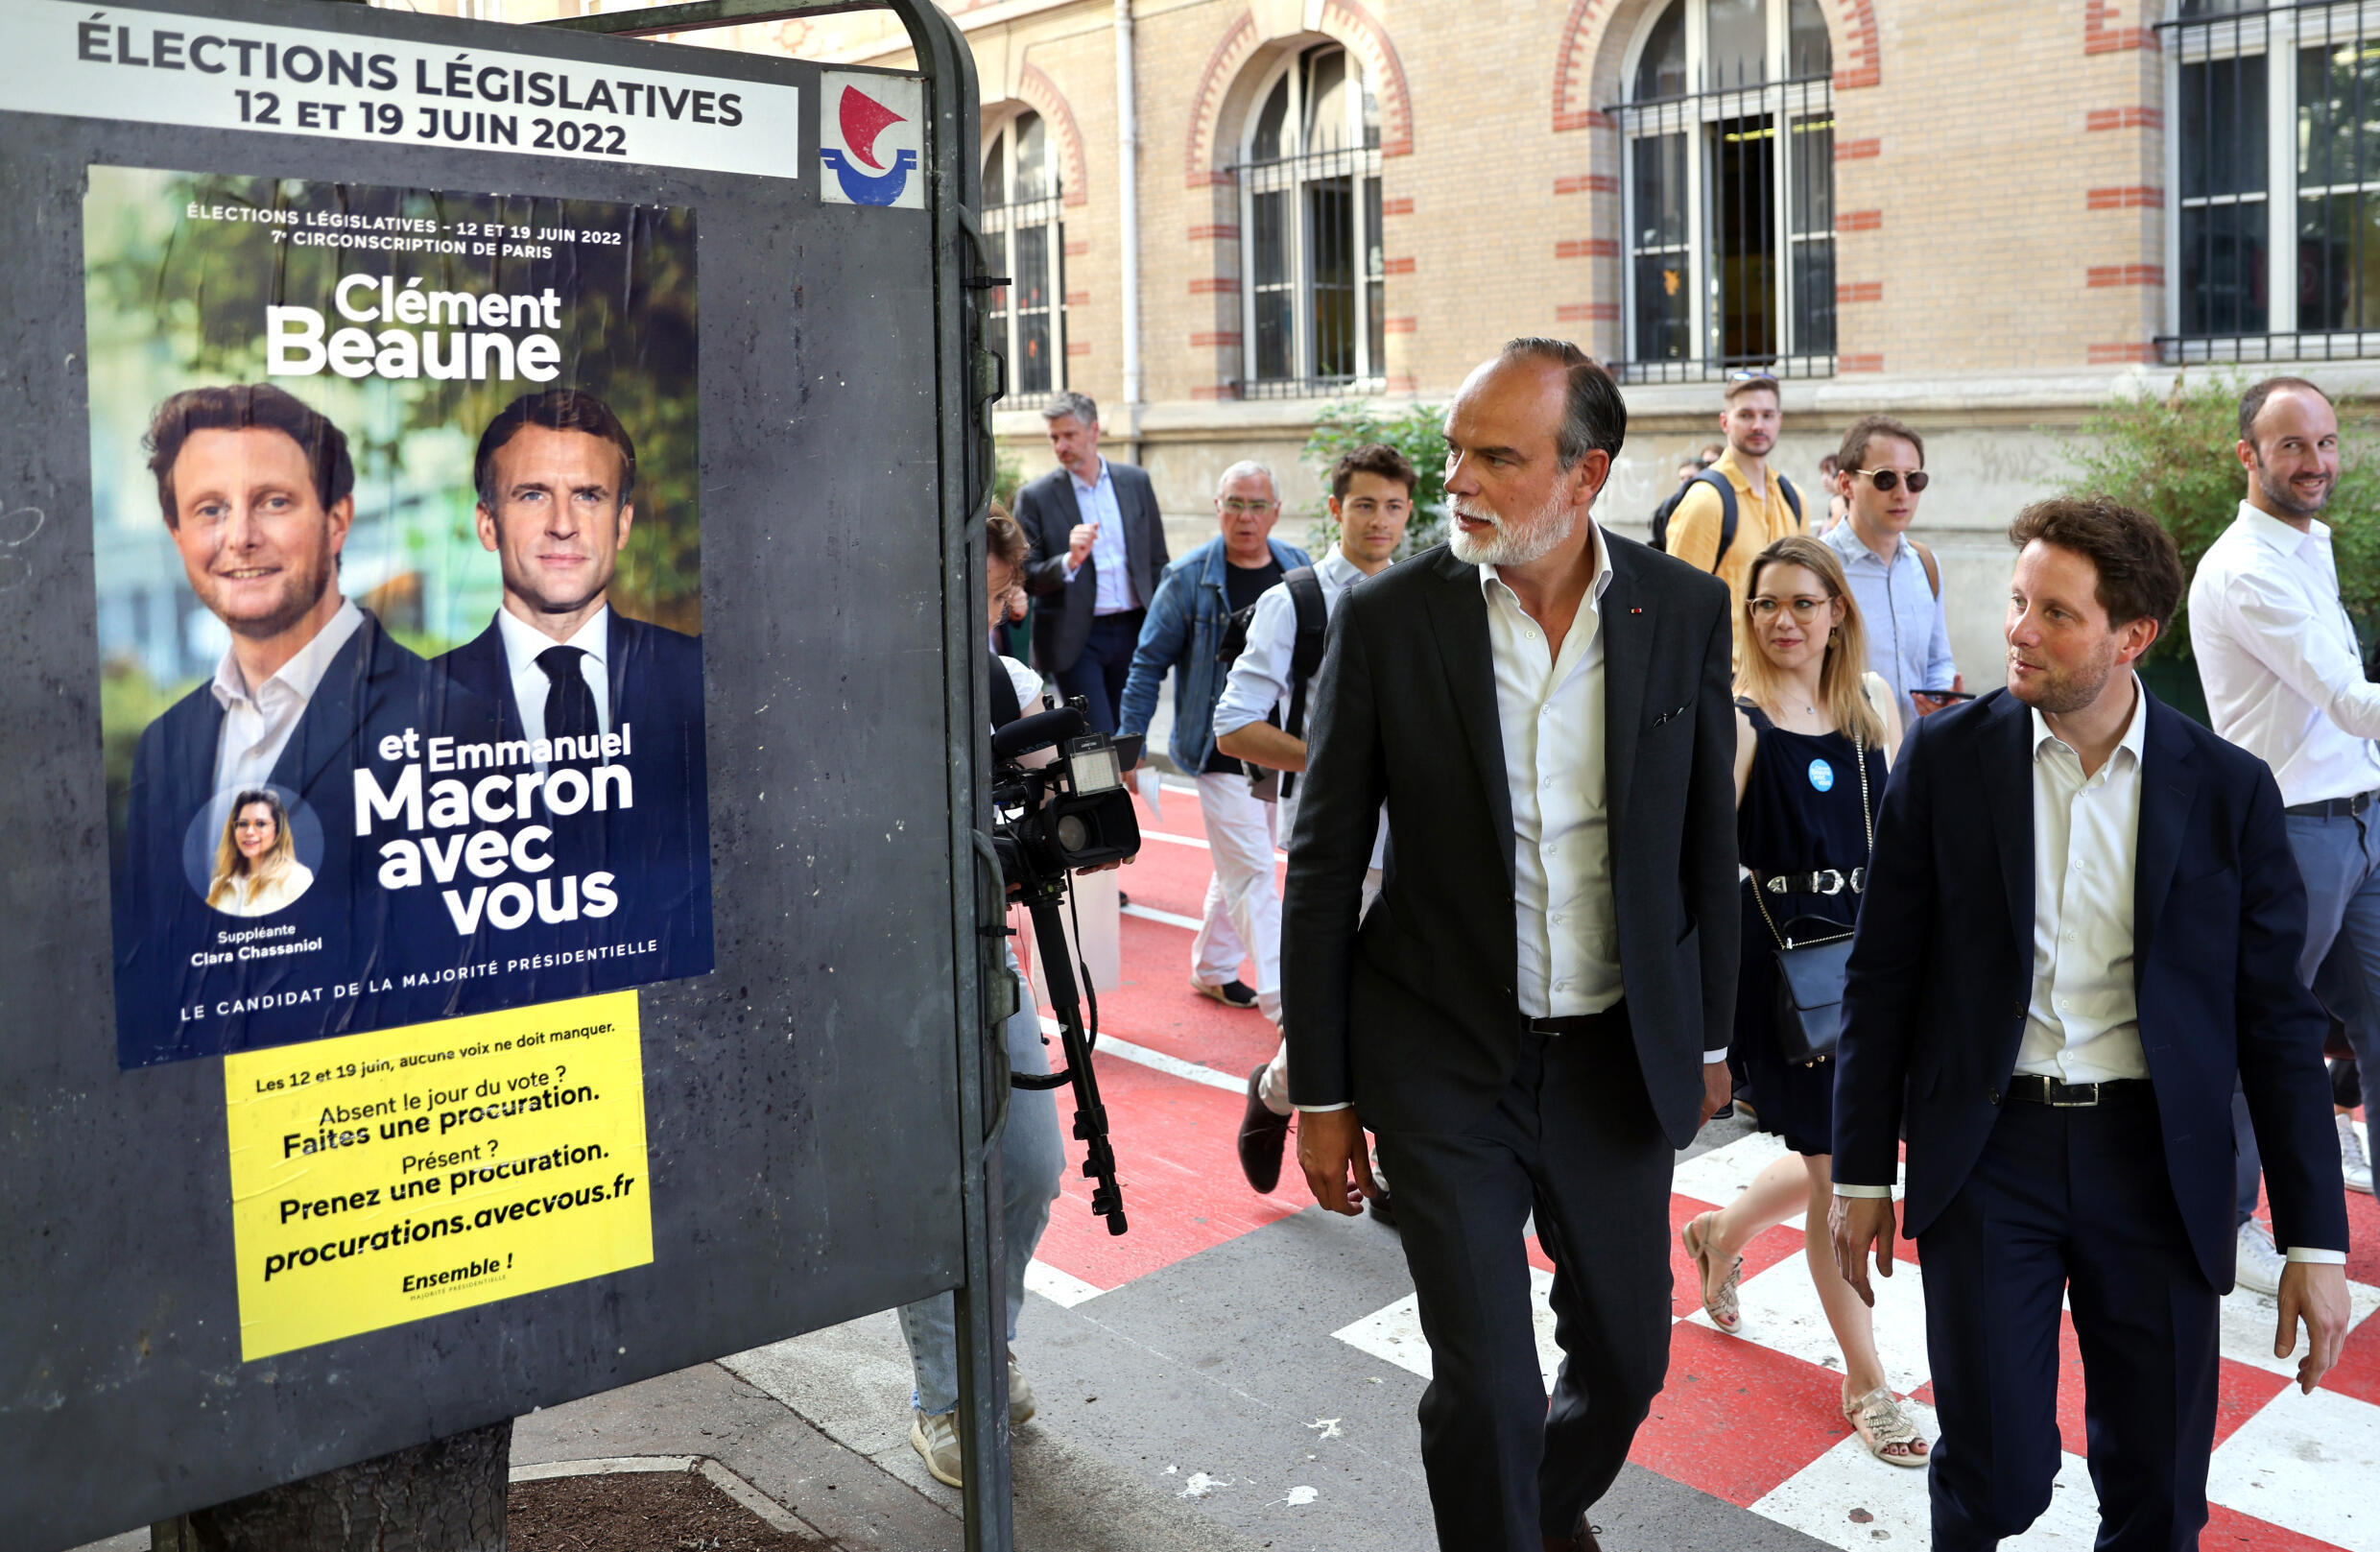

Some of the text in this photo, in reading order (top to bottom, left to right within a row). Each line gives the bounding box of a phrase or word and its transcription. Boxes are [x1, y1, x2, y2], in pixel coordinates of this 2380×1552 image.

[78, 12, 743, 128] ÉLECTIONS LÉGISLATIVES
[235, 89, 626, 155] 12 ET 19 JUIN 2022
[186, 202, 298, 225] ÉLECTIONS
[306, 210, 436, 233] LÉGISLATIVES
[457, 222, 477, 236] 12
[485, 224, 504, 237] ET
[511, 225, 531, 239] 19
[536, 227, 576, 242] JUIN
[582, 230, 622, 245] 2022
[294, 231, 465, 255] CIRCONSCRIPTION
[473, 243, 496, 256] DE
[503, 245, 553, 259] PARIS
[335, 273, 560, 329] Clément
[266, 304, 560, 382] Beaune
[379, 723, 631, 772] et Emmanuel
[354, 763, 632, 836] Macron
[378, 825, 555, 890] avec
[218, 923, 296, 946] Suppléante
[442, 872, 618, 936] vous
[180, 939, 657, 1021] LE CANDIDAT DE LA MAJORITÉ PRÉSIDENTIELLE
[191, 938, 322, 967] Clara Chassaniol
[256, 1022, 615, 1093] Les 12 et 19 juin, aucune voix ne doit manquer.
[284, 1085, 600, 1158] Faites une procuration.
[319, 1065, 567, 1127] Absent le jour du vote ?
[279, 1140, 609, 1225] Prenez une procuration.
[402, 1139, 499, 1175] Présent ?
[263, 1173, 634, 1280] procurations.avecvous.fr
[402, 1253, 512, 1293] Ensemble !
